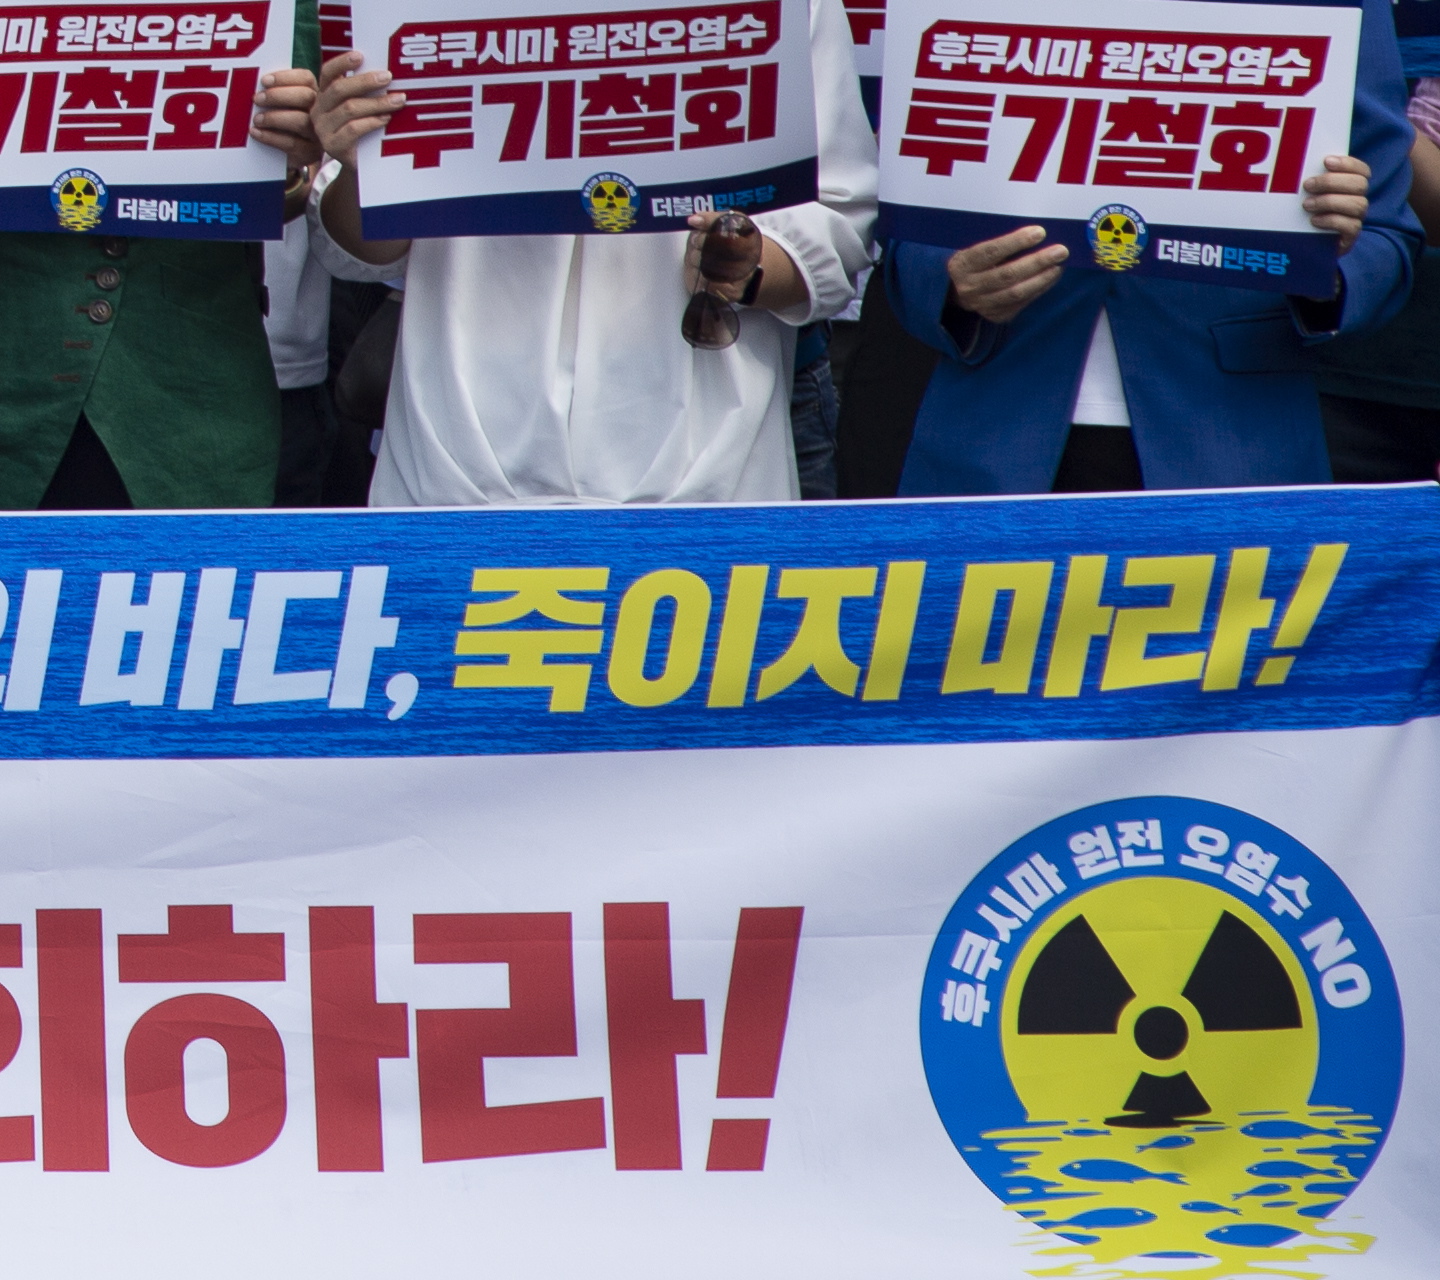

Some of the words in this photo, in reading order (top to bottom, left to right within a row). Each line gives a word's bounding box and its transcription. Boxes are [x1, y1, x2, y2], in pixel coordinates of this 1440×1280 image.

[57, 11, 254, 53] 원전오염수
[400, 27, 558, 70] 후쿠시마
[568, 12, 767, 62] 원전오염수
[928, 30, 1092, 79] 후쿠시마
[1101, 40, 1311, 87] 원전오염수
[380, 62, 780, 169] 투기철회
[899, 87, 1315, 195] 투기철회
[117, 197, 242, 223] 더불어민주당
[650, 185, 776, 220] 더불어민주당
[1159, 238, 1289, 276] 더불어민주당
[79, 566, 420, 721] 바다,
[453, 561, 927, 714] 죽이지
[940, 544, 1349, 697] 마라!
[942, 853, 1067, 1027] 후쿠시마
[1070, 819, 1165, 880] 원전
[1180, 825, 1312, 920] 오염수
[1299, 917, 1371, 1009] NO
